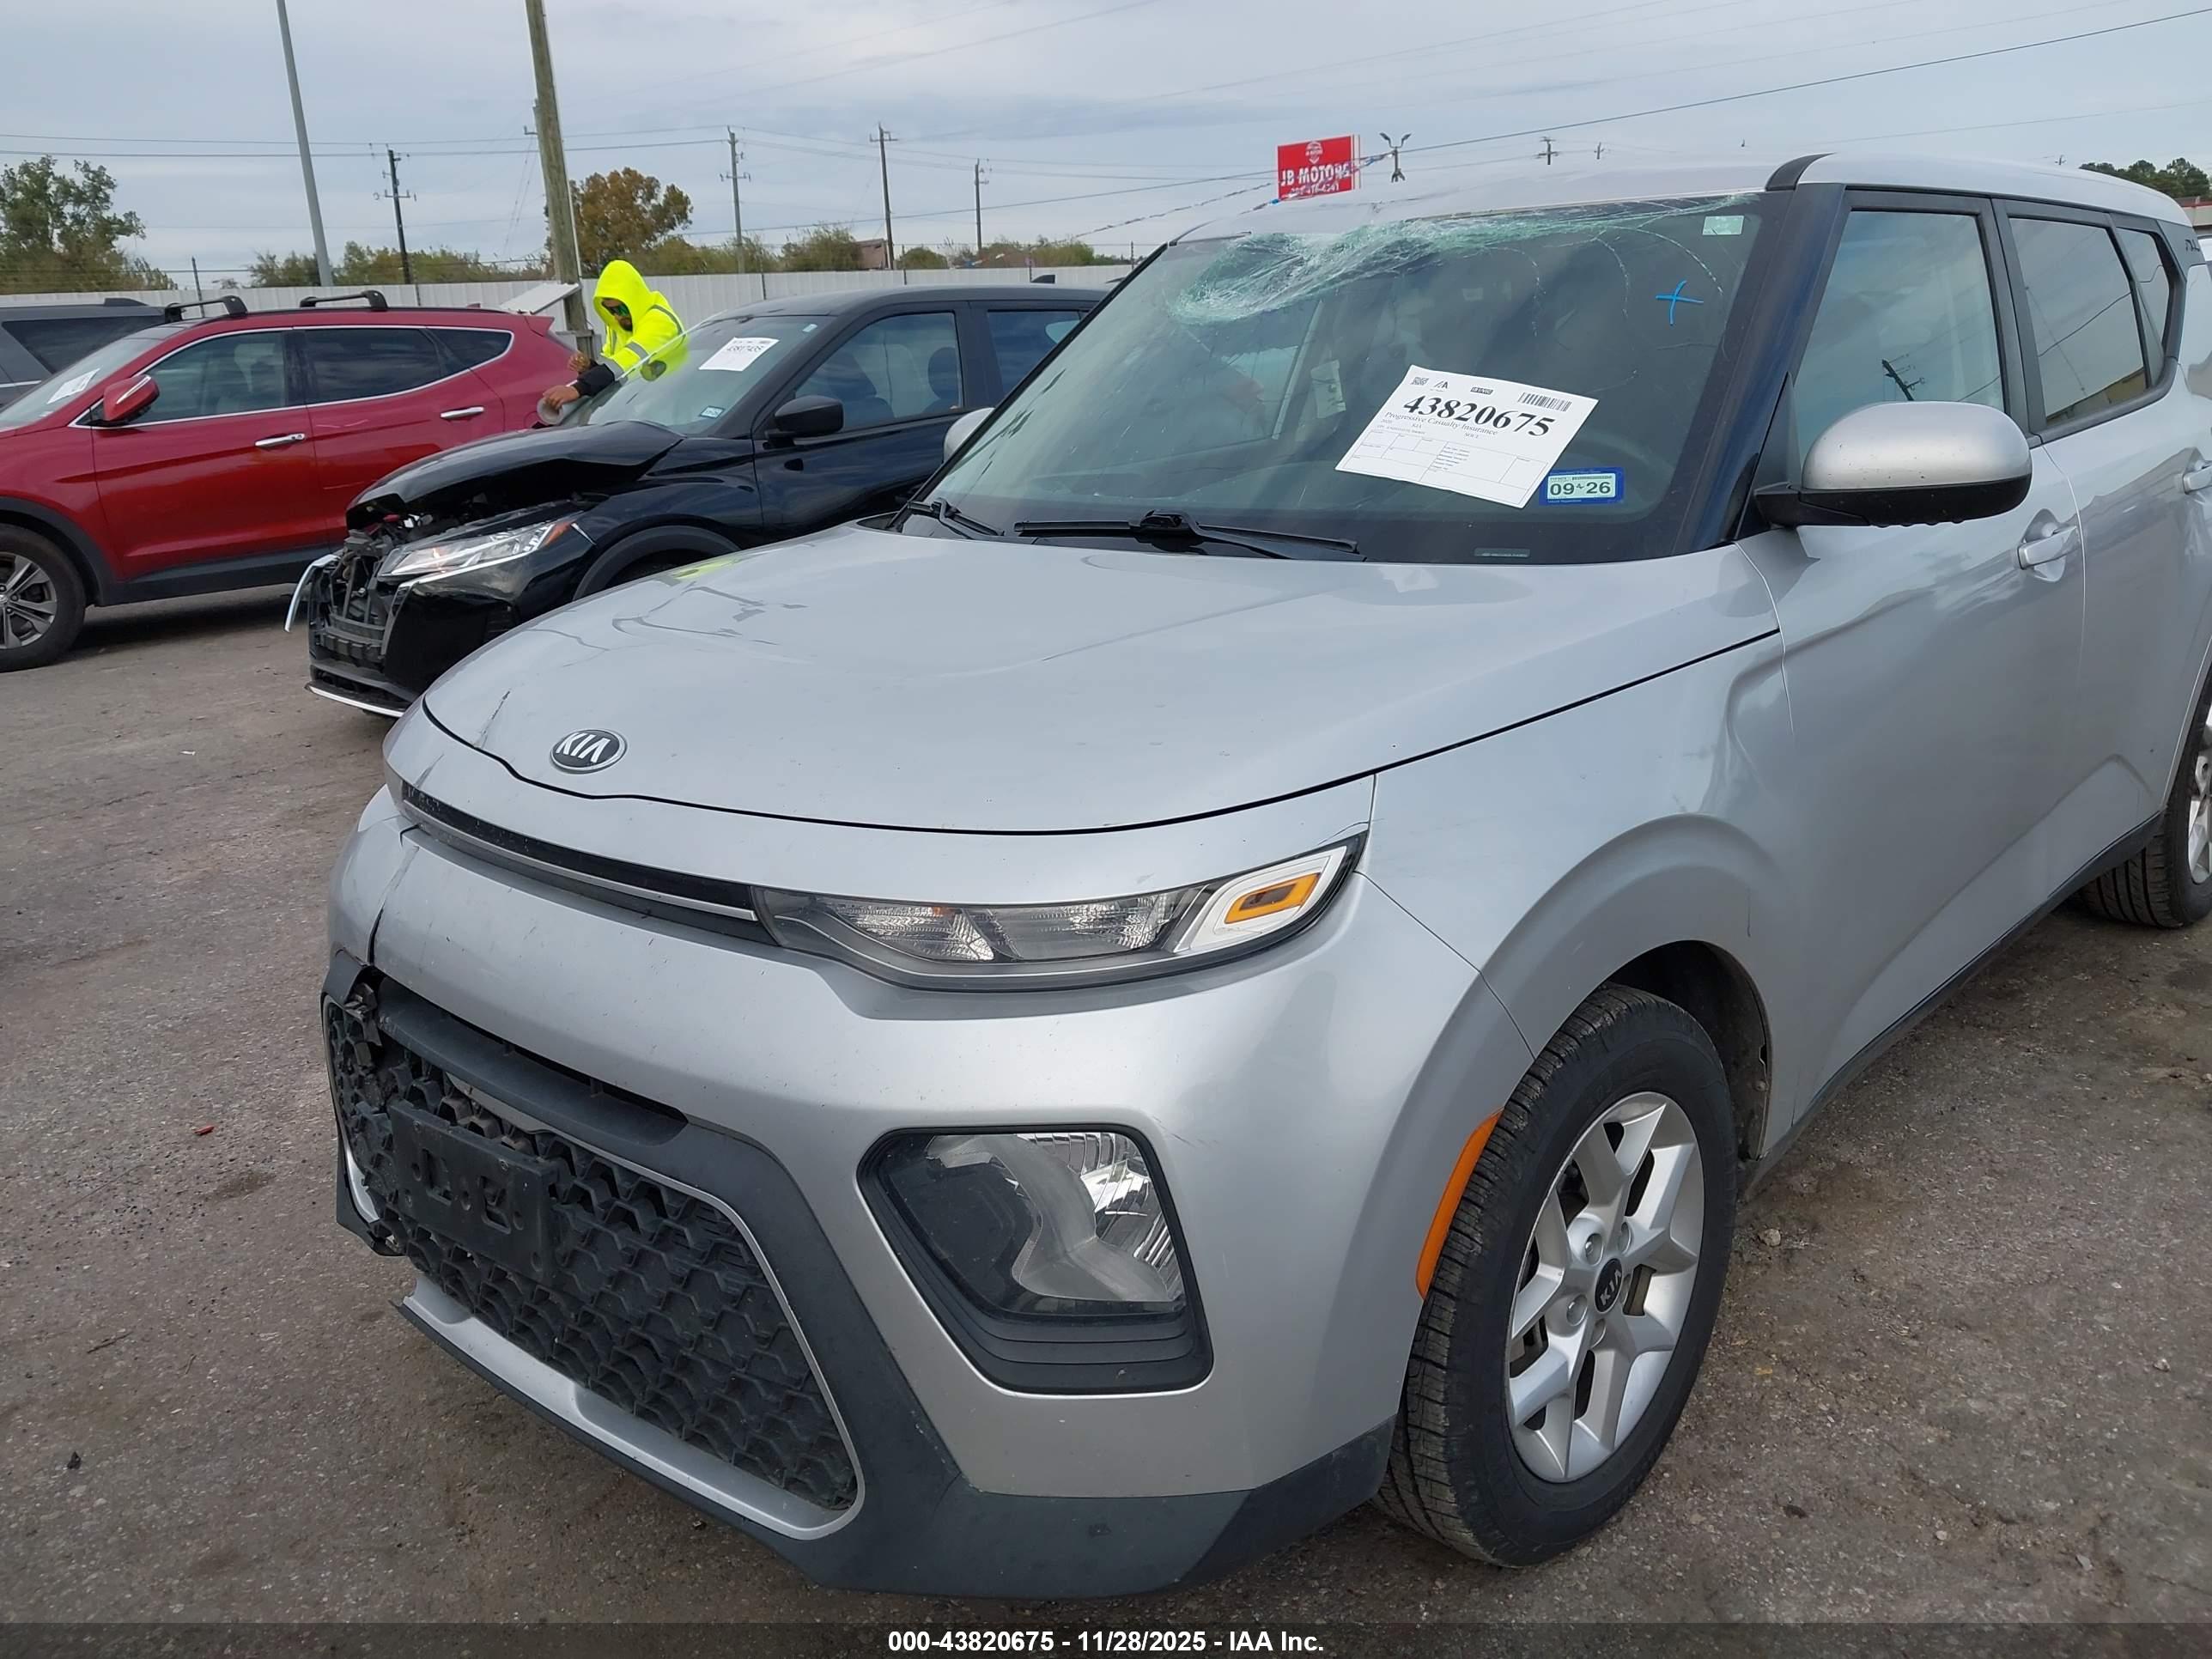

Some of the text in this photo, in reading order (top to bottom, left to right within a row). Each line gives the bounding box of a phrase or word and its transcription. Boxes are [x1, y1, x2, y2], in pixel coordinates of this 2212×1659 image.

[1280, 162, 1350, 186] JB MOTORS
[1384, 411, 1498, 436] Progressive Casualty Insurance
[1403, 395, 1556, 436] 43820675
[1550, 481, 1611, 495] 09 26
[555, 732, 611, 763] KIA
[1600, 1268, 1622, 1306] KIA
